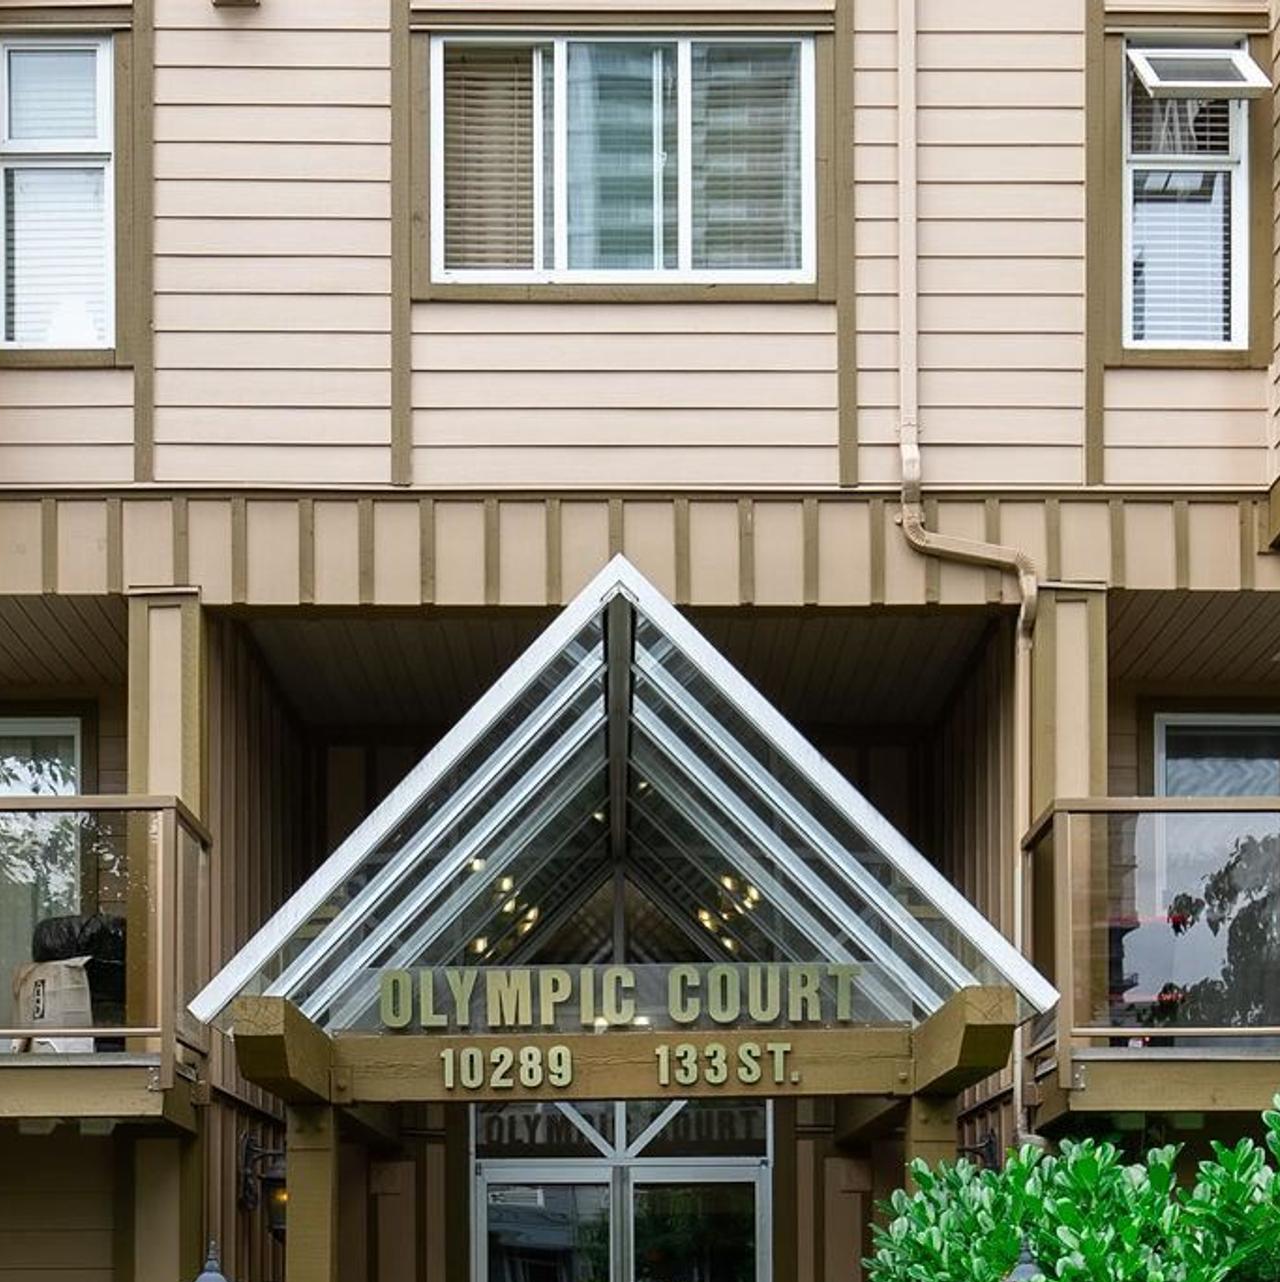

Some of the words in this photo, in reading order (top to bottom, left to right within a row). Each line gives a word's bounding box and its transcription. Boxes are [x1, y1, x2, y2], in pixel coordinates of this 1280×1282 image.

[380, 967, 635, 1028] OLYMPIC
[668, 965, 861, 1023] COURT
[439, 1044, 572, 1089] 10289
[648, 1109, 759, 1141] OURT
